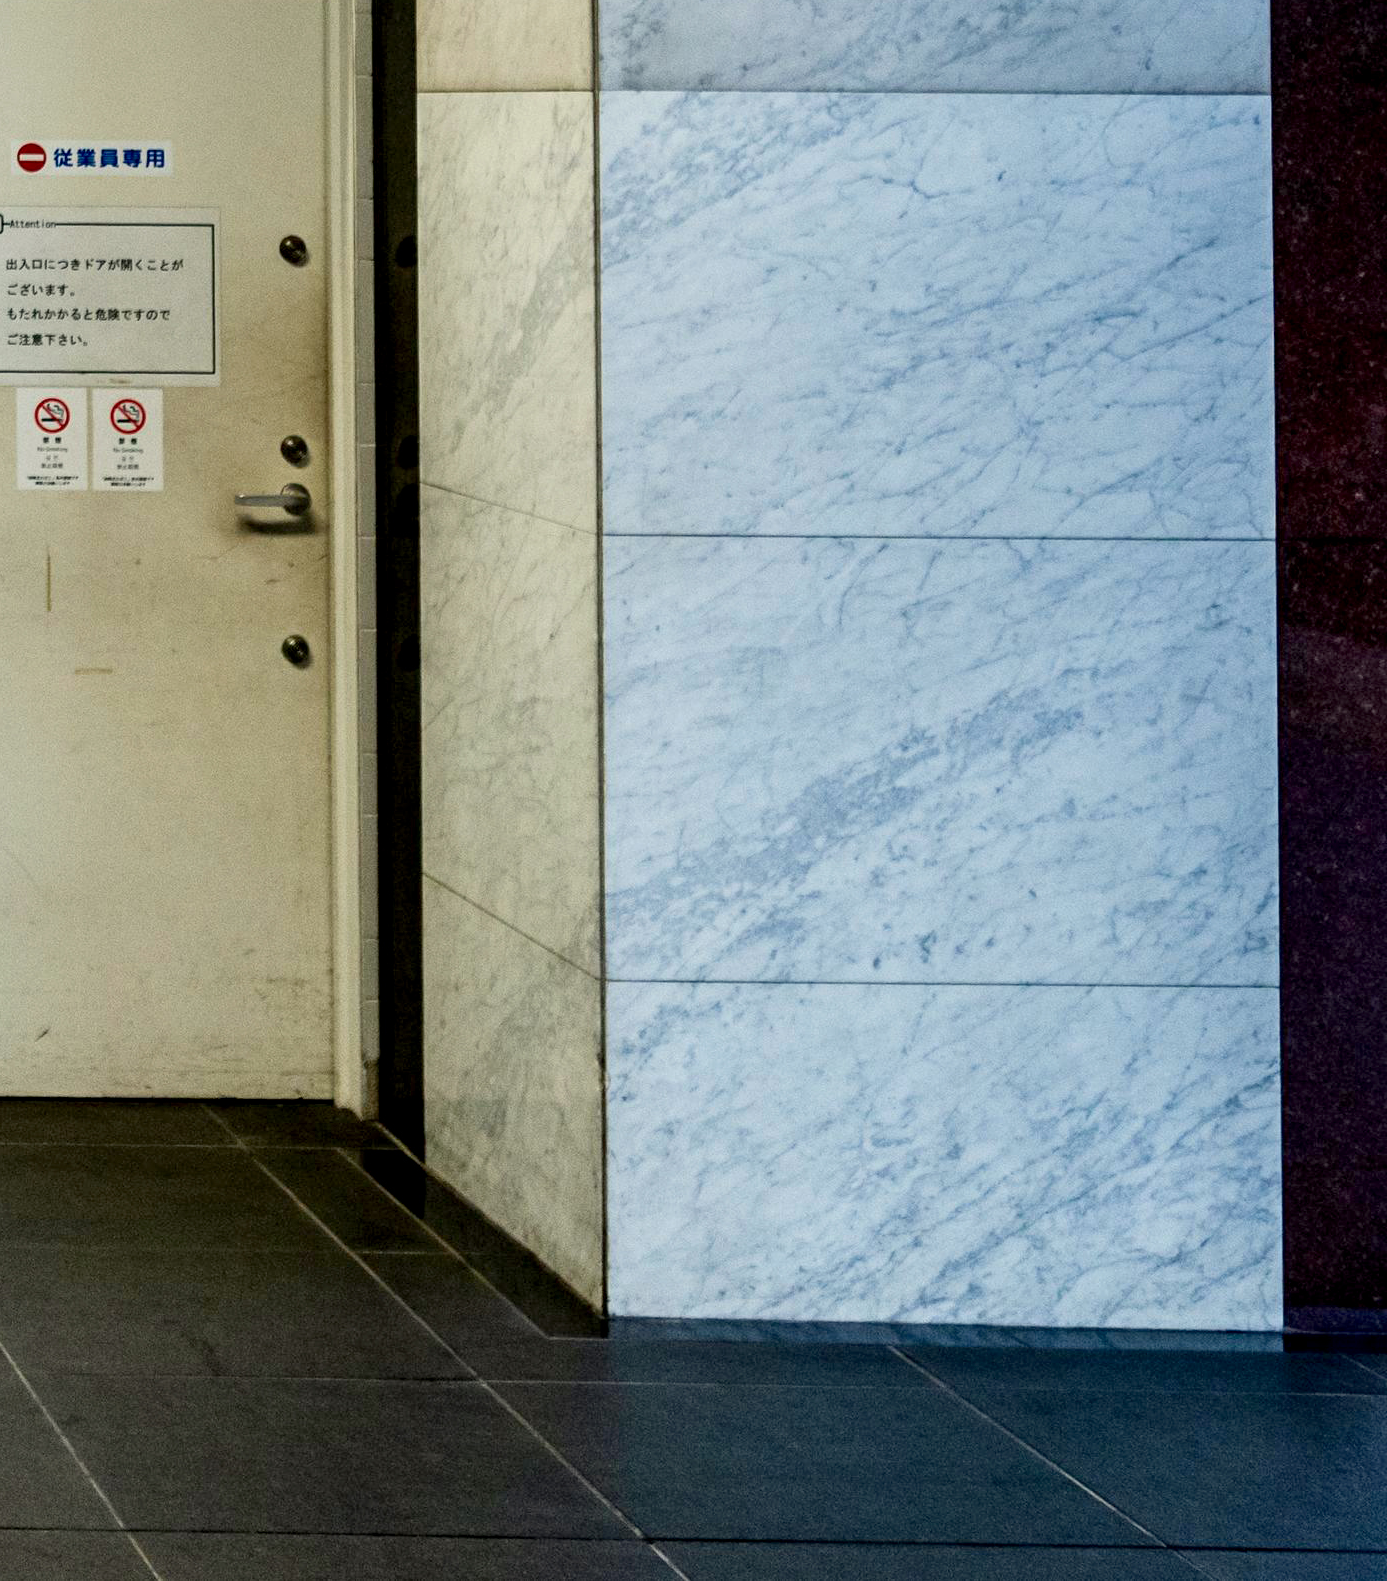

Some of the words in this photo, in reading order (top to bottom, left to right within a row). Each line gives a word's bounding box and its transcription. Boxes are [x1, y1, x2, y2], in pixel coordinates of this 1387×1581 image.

[53, 148, 165, 169] 従業員専用
[9, 219, 56, 229] Attention
[5, 258, 184, 271] 出入口につきドアが開くことが
[7, 283, 76, 297] ございます。
[7, 308, 170, 321] もたれかかると危険ですので
[7, 334, 88, 347] ご注意下さい。
